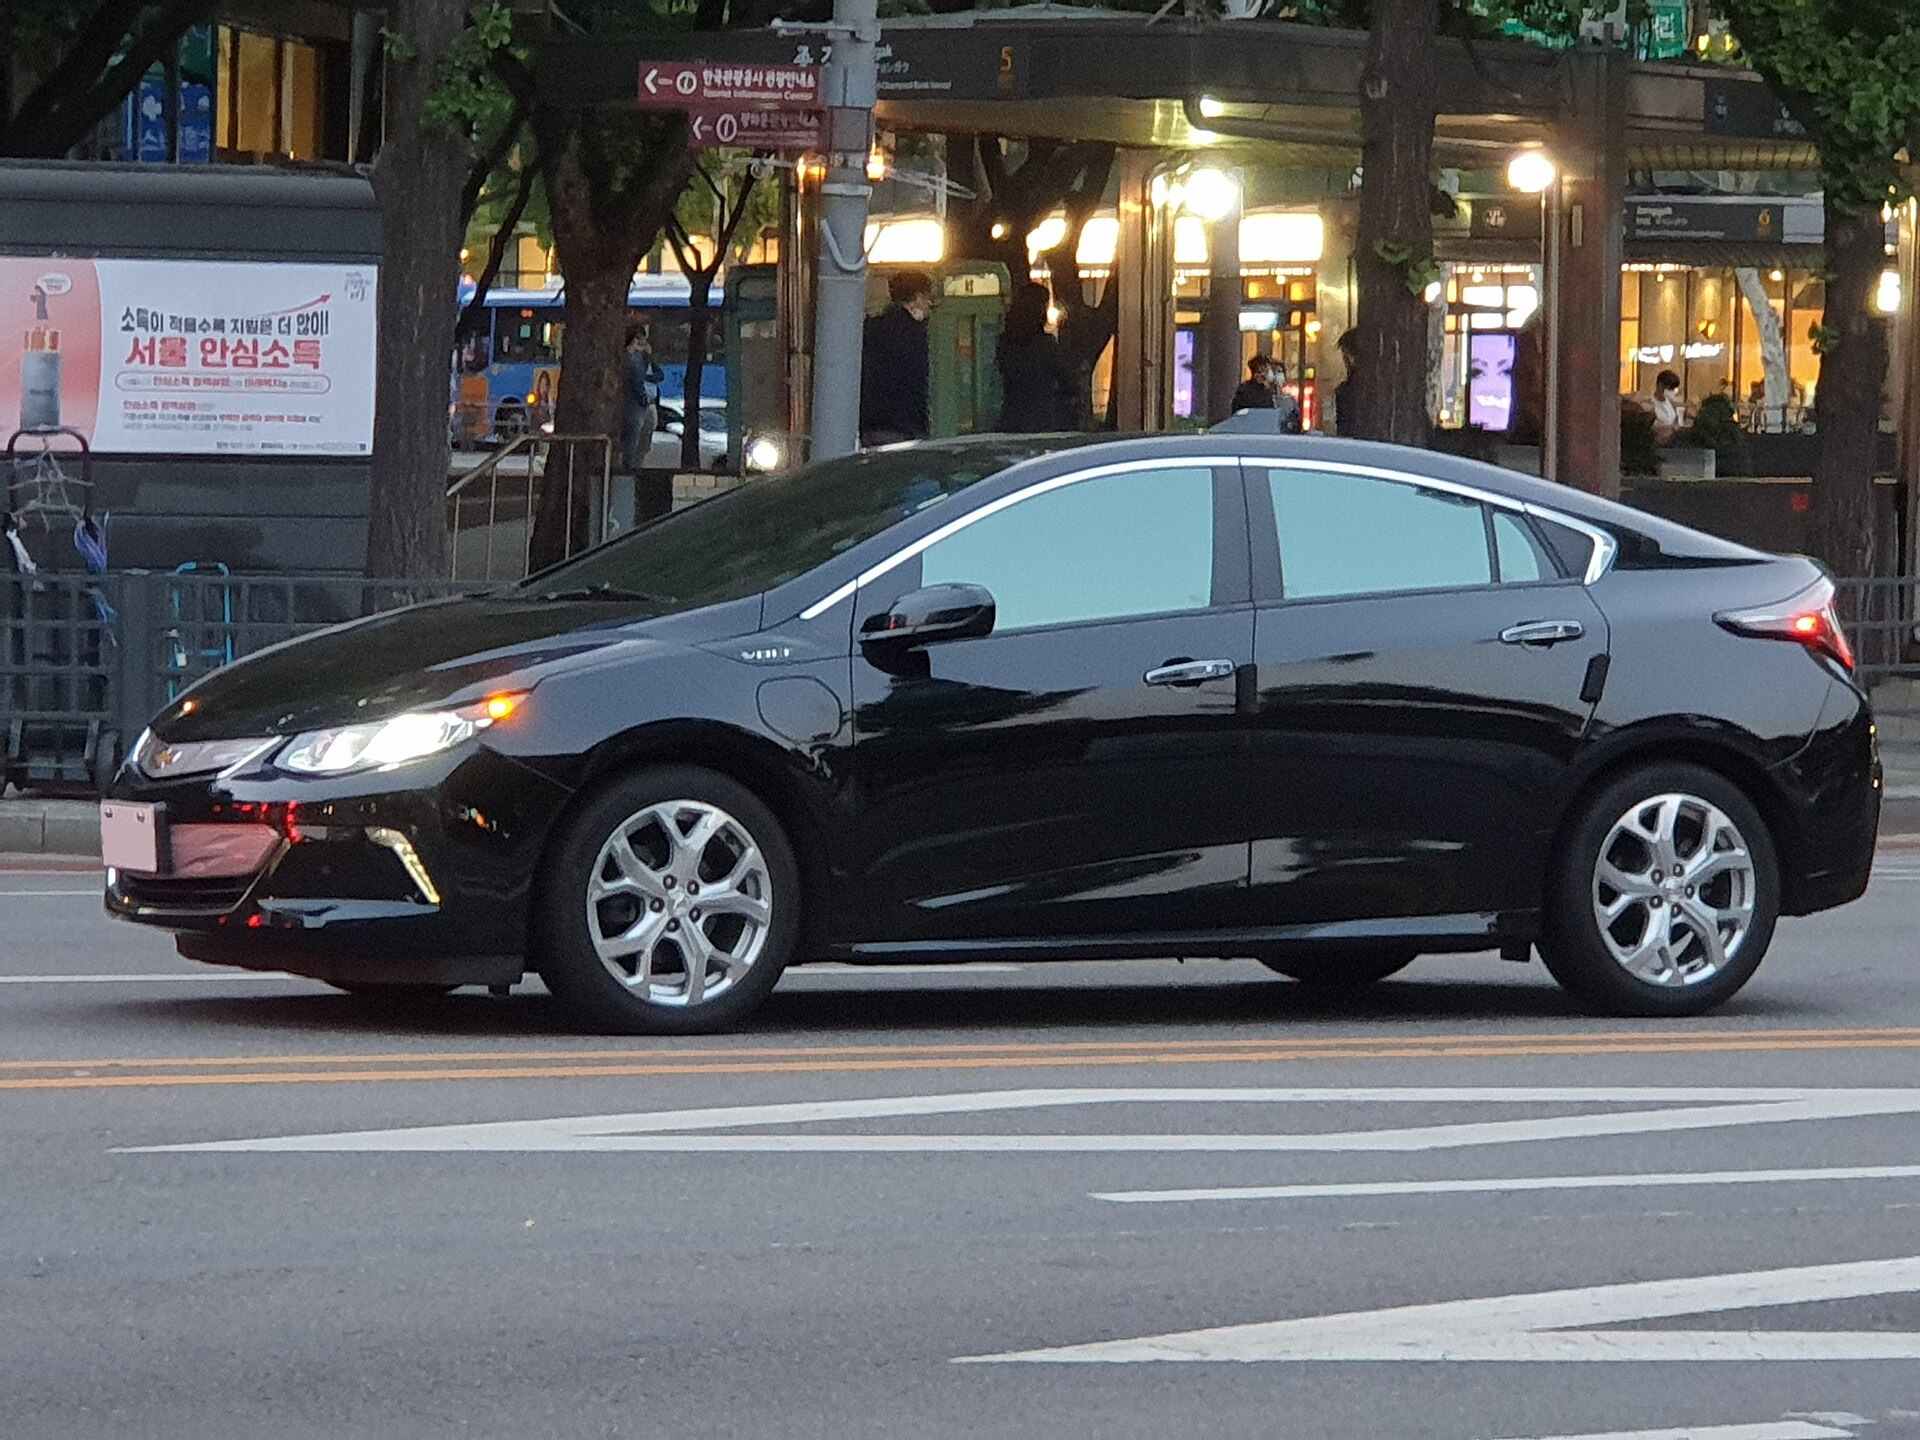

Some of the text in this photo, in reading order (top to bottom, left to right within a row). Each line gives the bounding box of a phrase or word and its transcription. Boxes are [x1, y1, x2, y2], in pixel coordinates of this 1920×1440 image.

[703, 87, 813, 100] Tourist Information Center
[121, 306, 164, 333] 소득이
[277, 316, 291, 335] 더
[125, 336, 321, 369] 서울 안심소득
